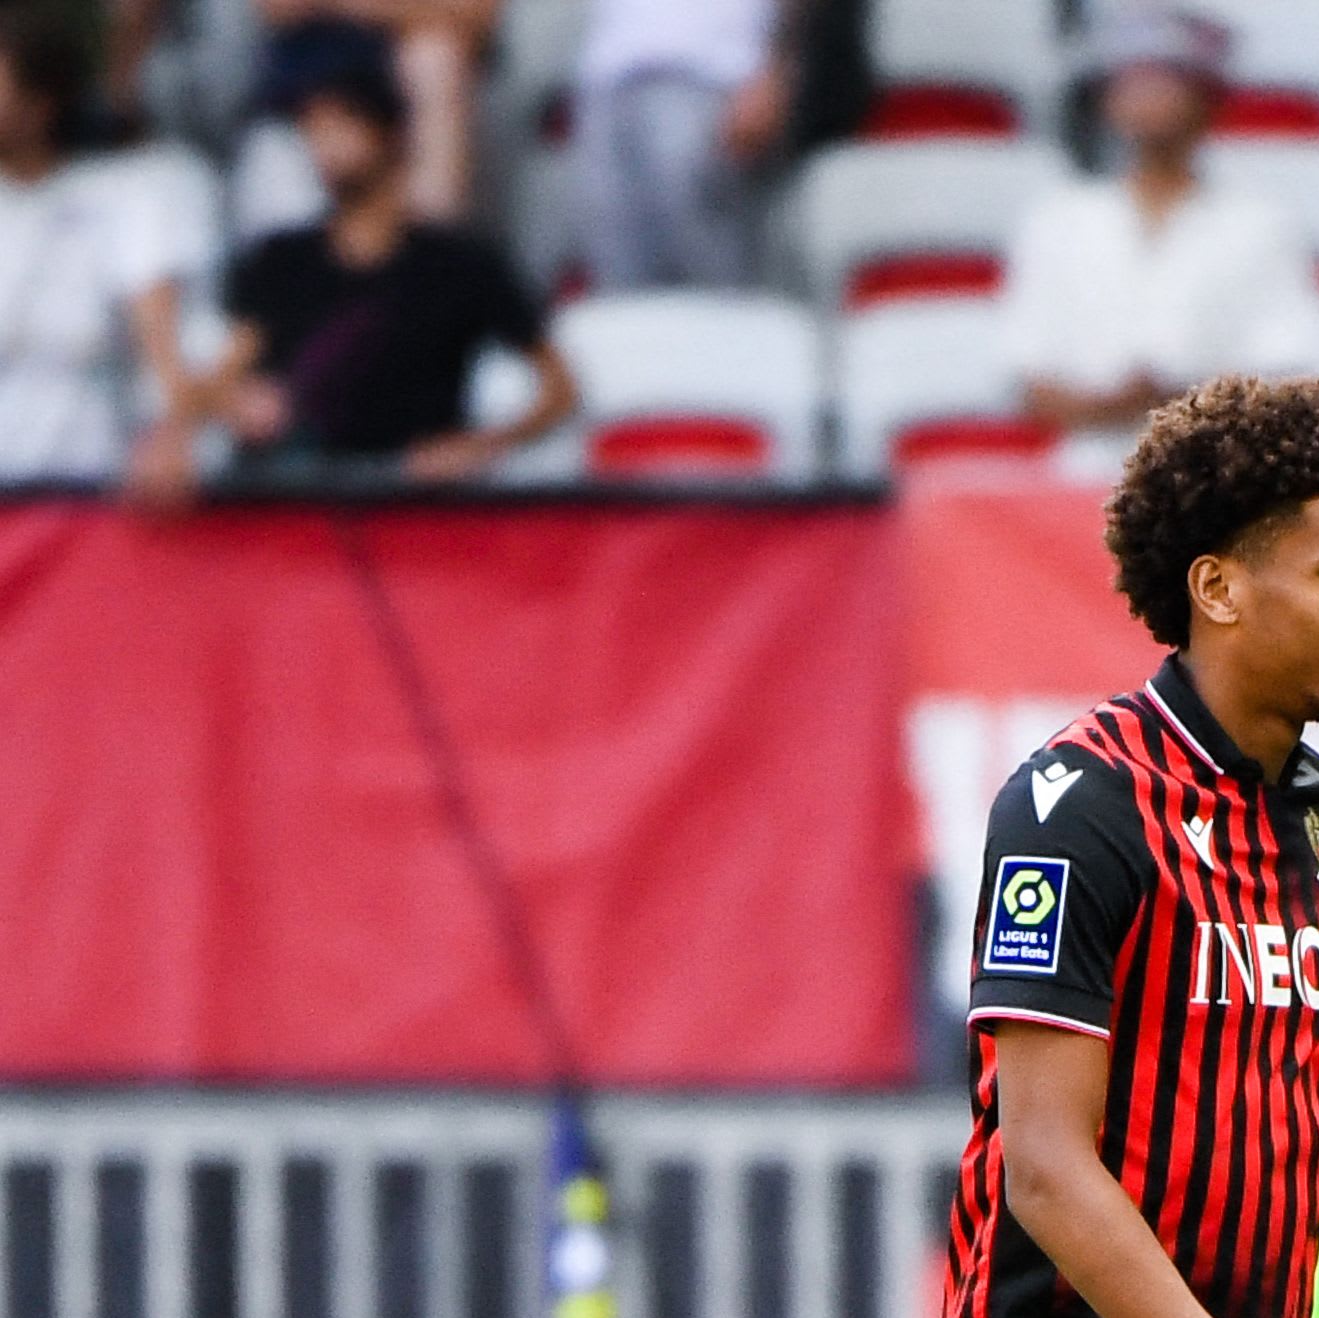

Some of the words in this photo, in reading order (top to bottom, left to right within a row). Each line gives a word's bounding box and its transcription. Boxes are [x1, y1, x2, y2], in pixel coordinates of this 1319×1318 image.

[998, 930, 1038, 944] LIGUE
[1041, 932, 1048, 944] 1
[993, 945, 1020, 957] Uber
[1020, 945, 1050, 960] Eats
